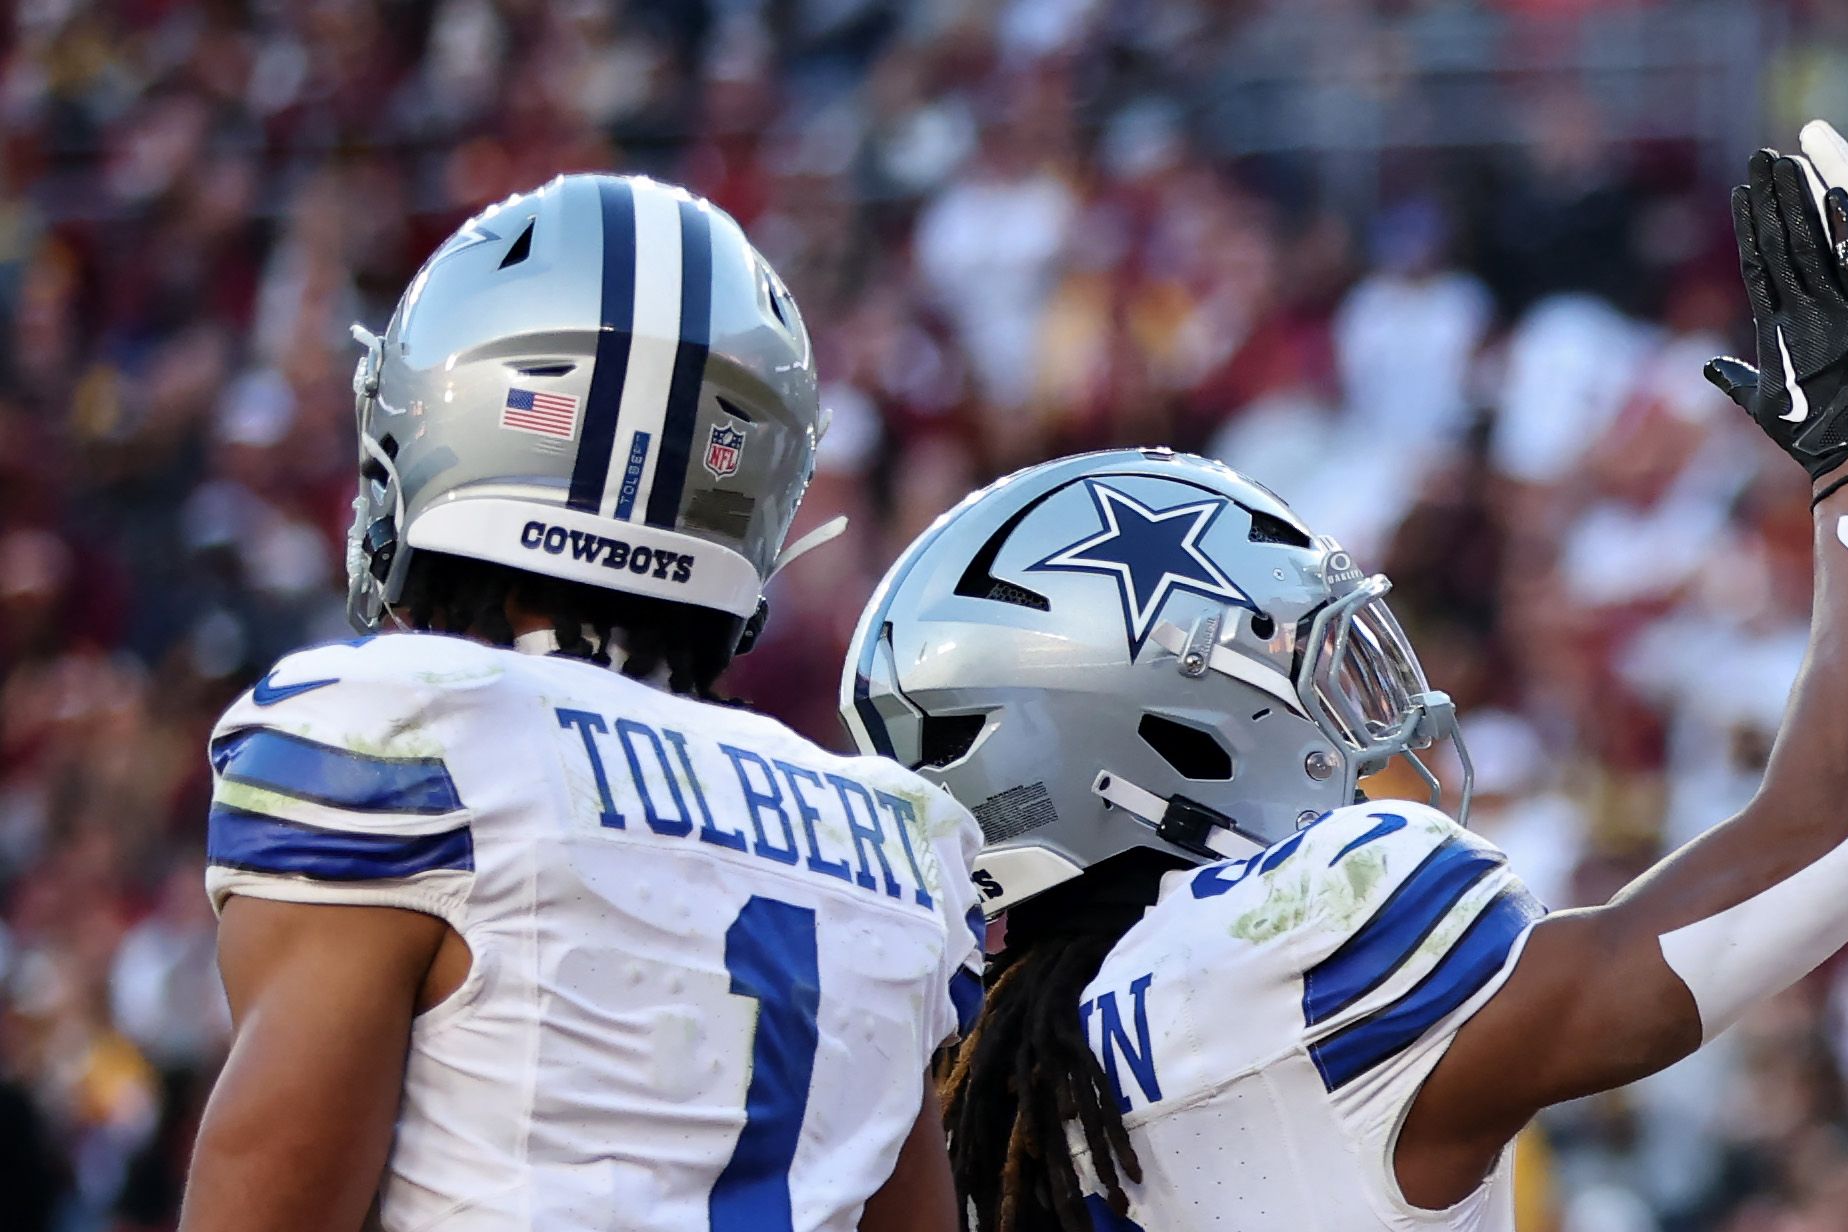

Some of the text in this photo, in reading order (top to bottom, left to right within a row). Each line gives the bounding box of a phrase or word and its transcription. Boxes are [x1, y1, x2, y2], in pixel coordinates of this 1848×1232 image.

[707, 444, 736, 471] NFL
[520, 520, 696, 584] COWBOYS
[555, 707, 934, 911] TOLBERT
